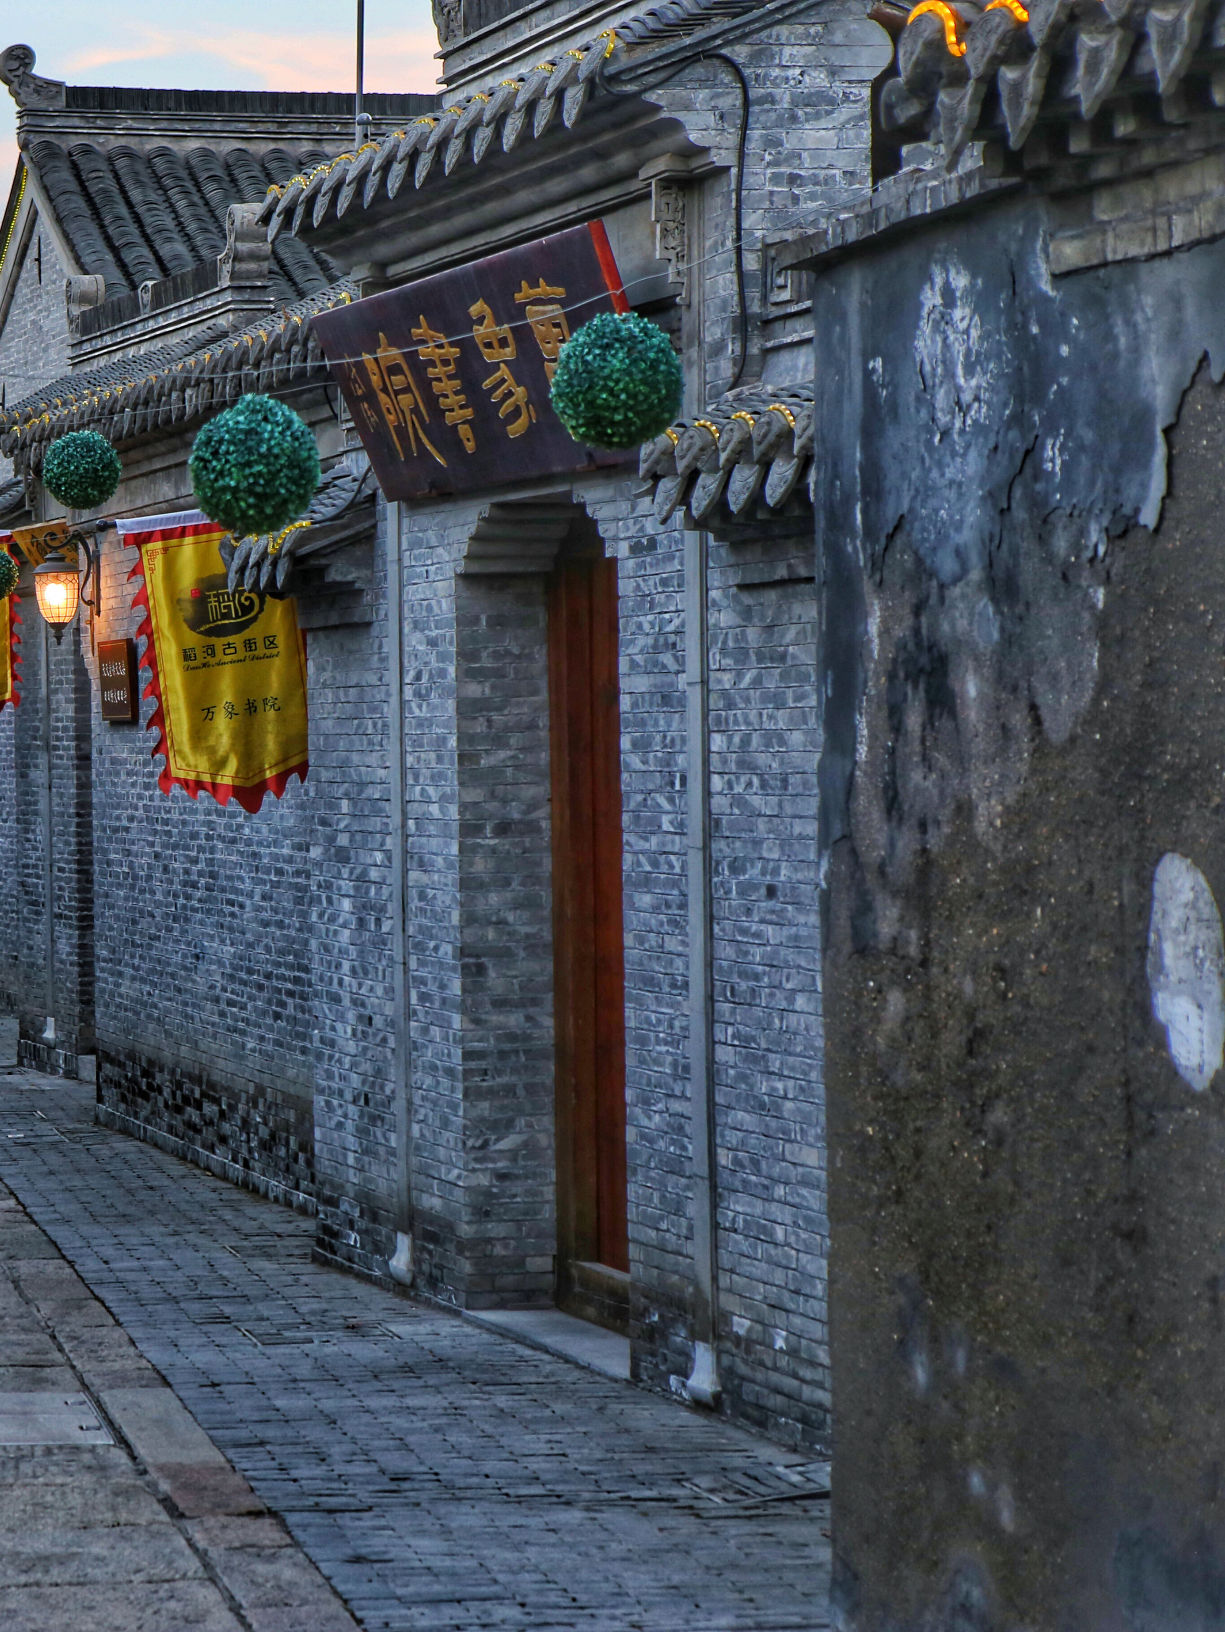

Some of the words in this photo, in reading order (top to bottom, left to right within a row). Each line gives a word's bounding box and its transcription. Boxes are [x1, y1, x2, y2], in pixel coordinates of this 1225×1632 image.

[182, 635, 279, 662] 稻河古街区
[201, 696, 281, 721] 万象书院
